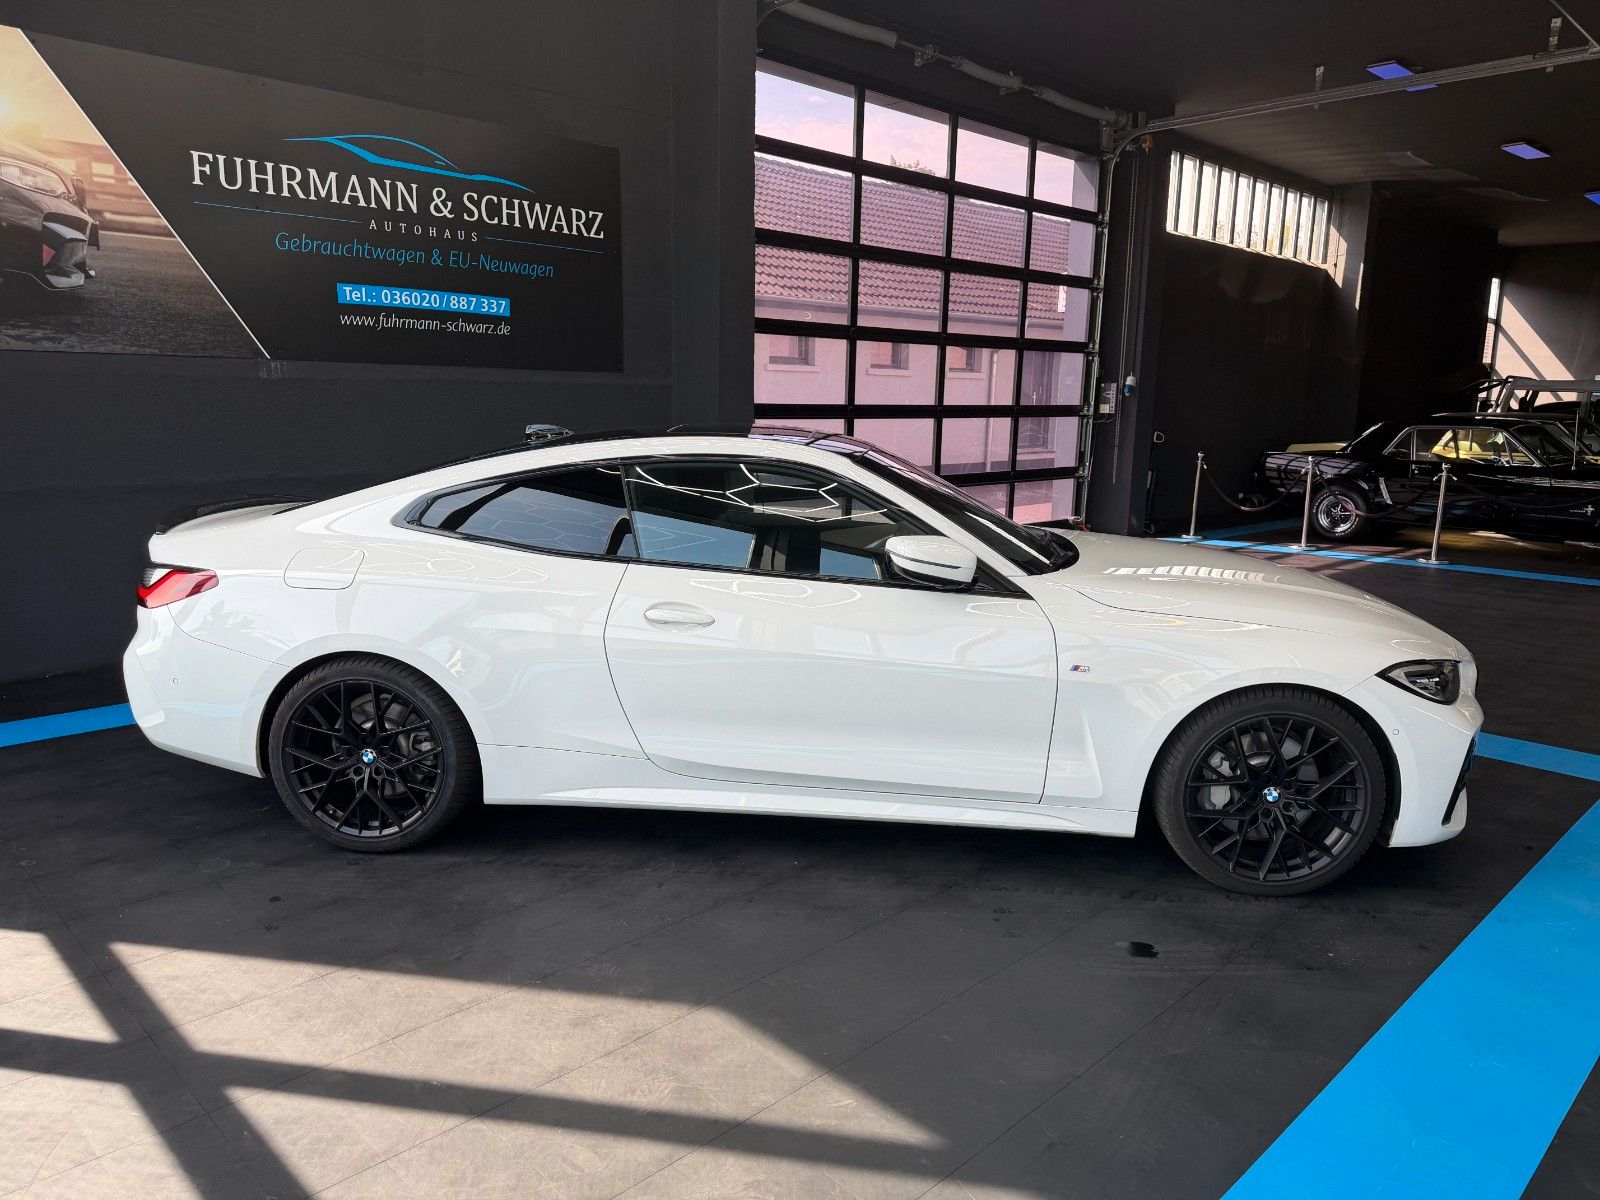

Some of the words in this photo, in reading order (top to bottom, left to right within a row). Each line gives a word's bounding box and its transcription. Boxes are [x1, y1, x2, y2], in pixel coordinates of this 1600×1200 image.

[189, 150, 418, 214] FUHRMANN
[429, 187, 455, 218] &
[463, 192, 604, 239] SCHWARZ
[369, 219, 478, 242] AUTOHAUS
[275, 231, 425, 267] Gebrauchtwagen
[431, 248, 443, 266] &
[449, 251, 554, 280] EU-Neuwagen
[343, 287, 376, 303] Tel.:
[480, 298, 506, 314] 337
[340, 312, 511, 336] www.fuhrmann-schwarz.de
